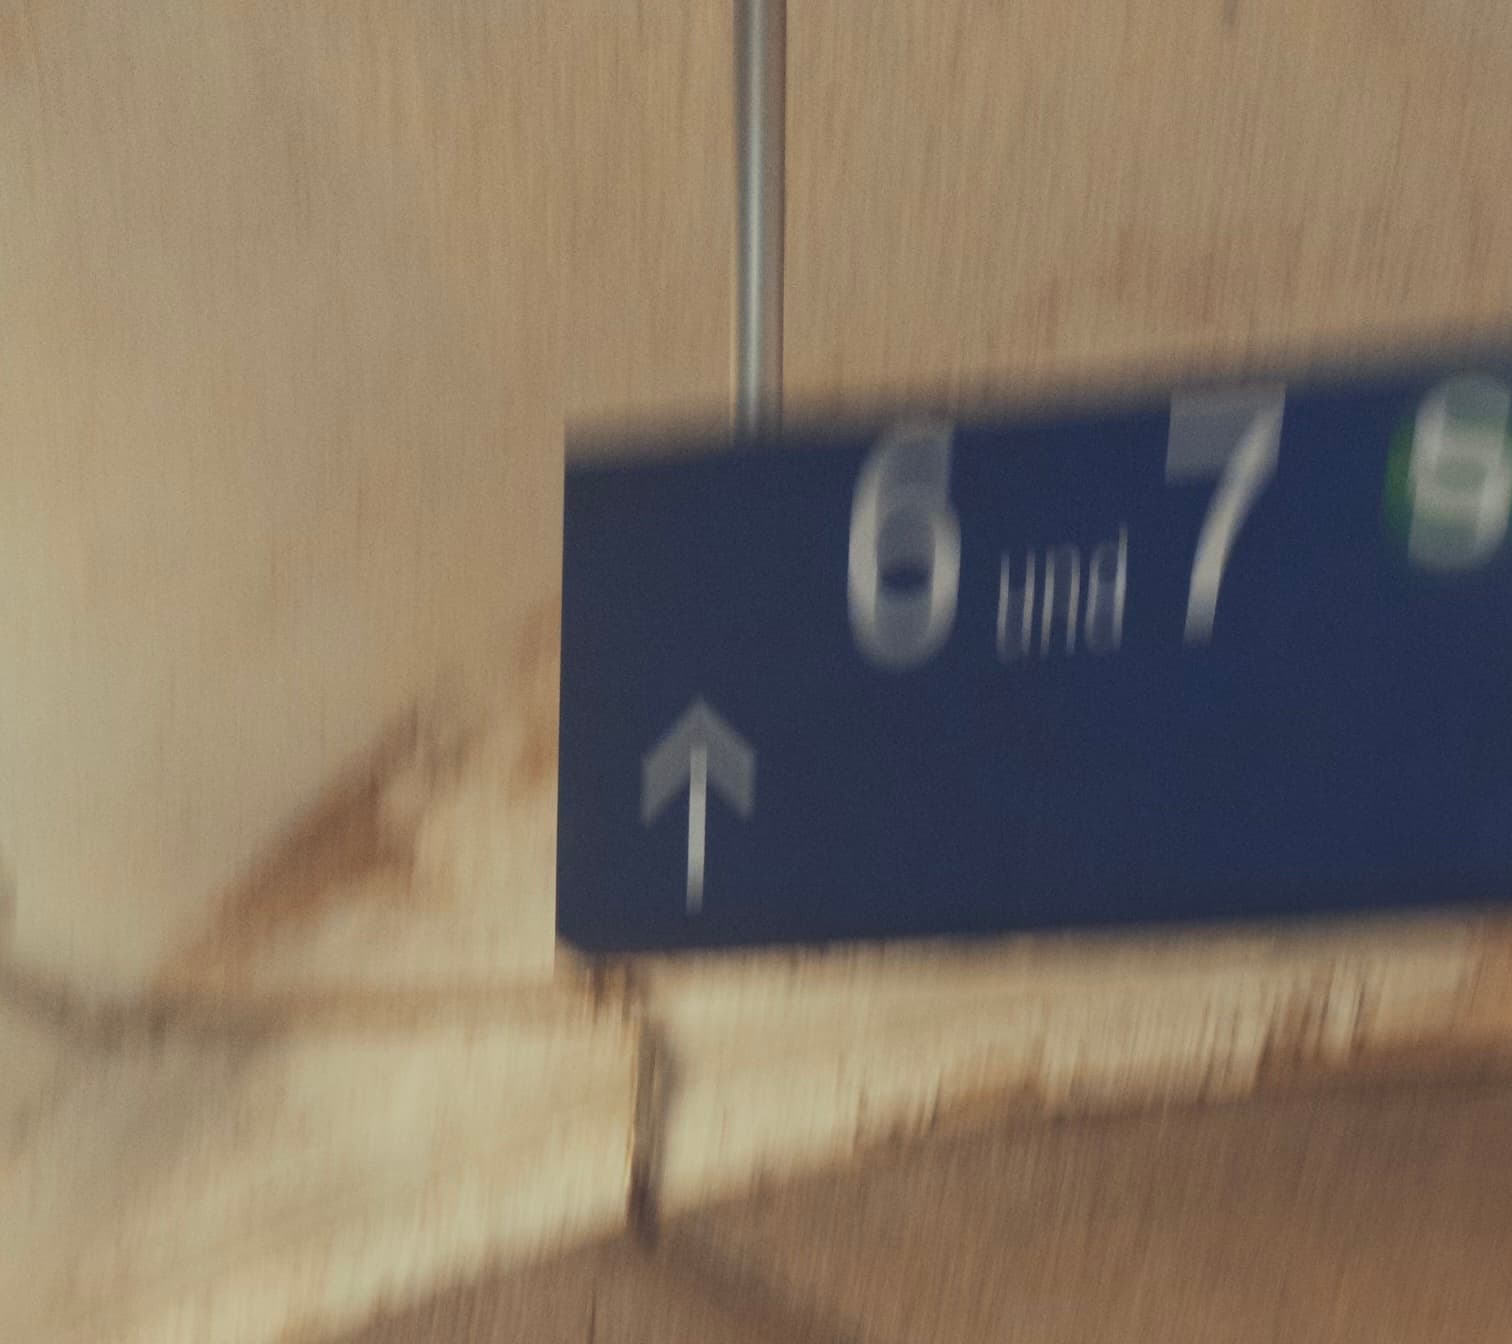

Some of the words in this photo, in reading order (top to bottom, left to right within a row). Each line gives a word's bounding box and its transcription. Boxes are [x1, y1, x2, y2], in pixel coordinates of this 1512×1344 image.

[847, 416, 962, 670] 6
[997, 522, 1129, 661] und
[1165, 382, 1287, 648] 7
